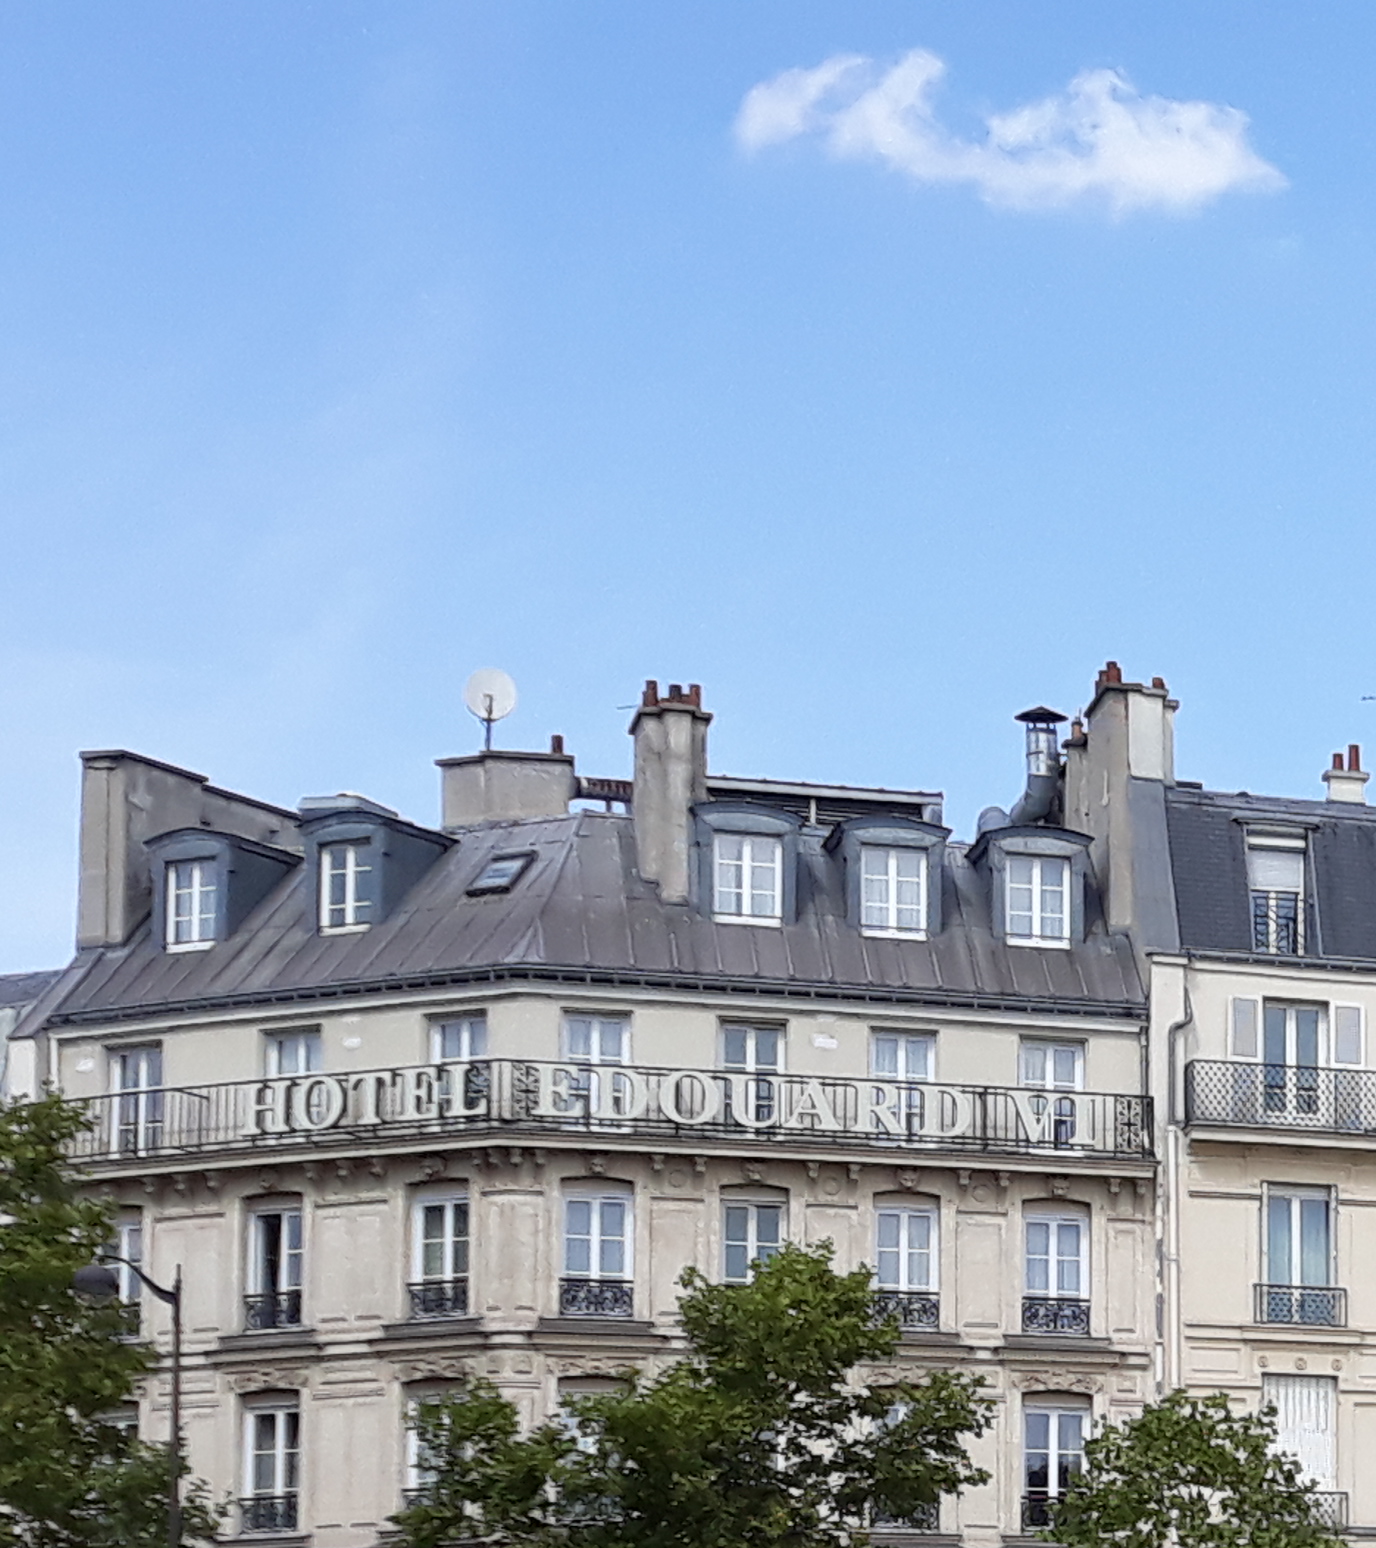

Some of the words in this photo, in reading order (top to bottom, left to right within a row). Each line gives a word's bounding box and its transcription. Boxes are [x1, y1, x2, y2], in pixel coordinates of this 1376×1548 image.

[241, 1064, 488, 1136] HOTEL
[531, 1065, 972, 1137] EDOUARD
[1012, 1091, 1098, 1147] VI
